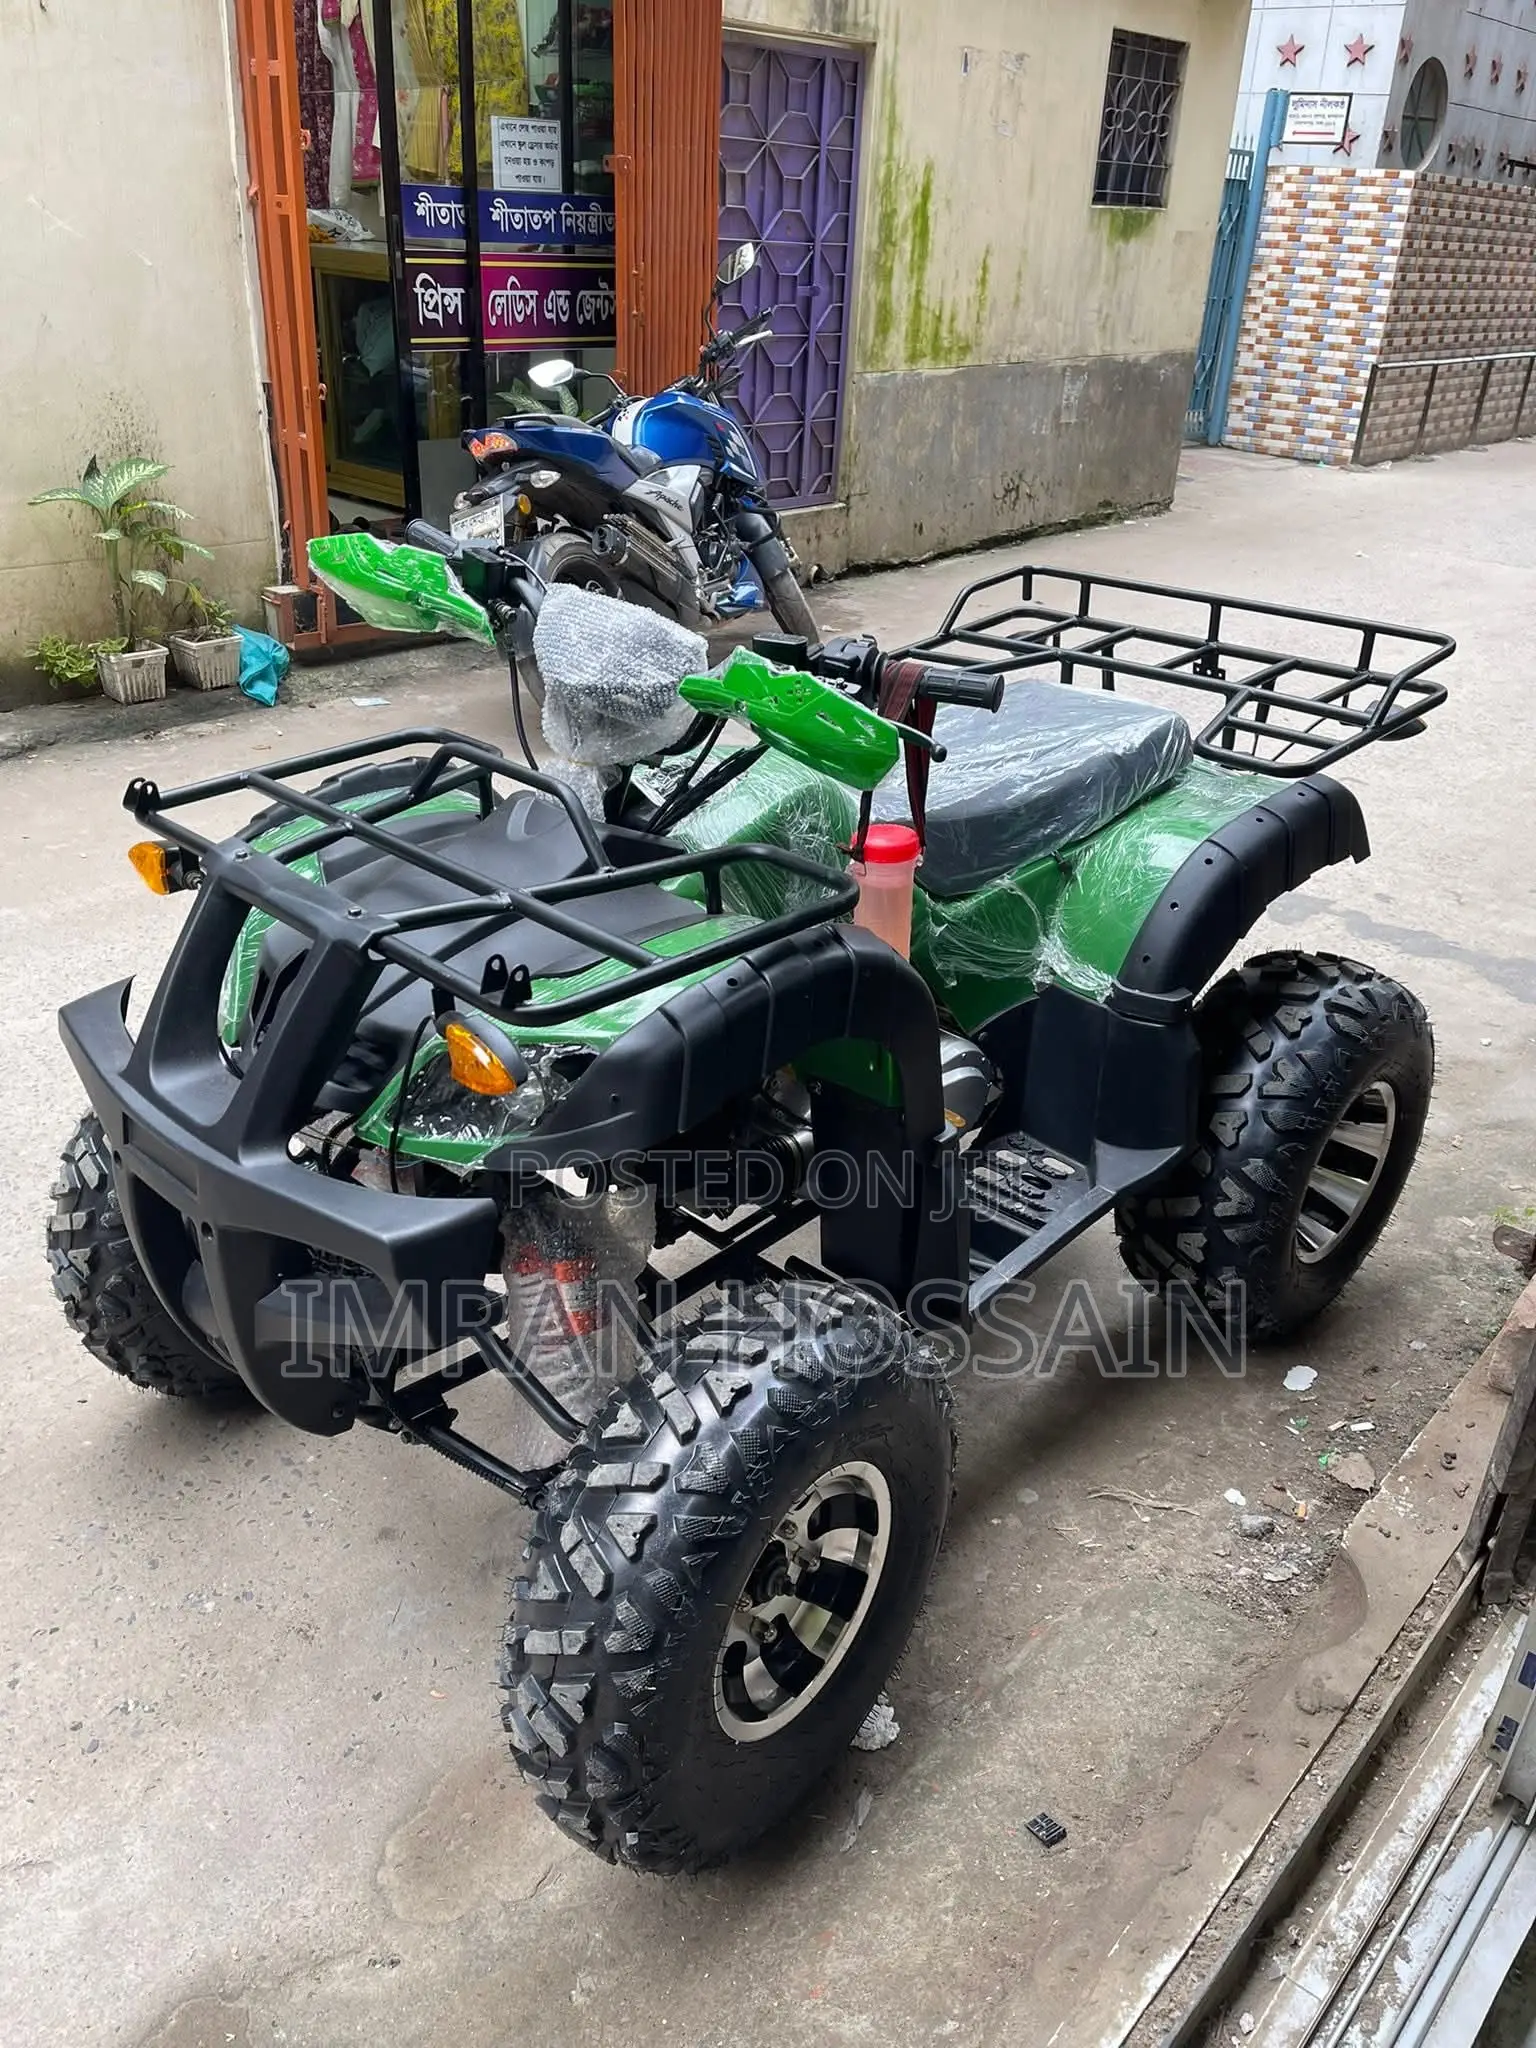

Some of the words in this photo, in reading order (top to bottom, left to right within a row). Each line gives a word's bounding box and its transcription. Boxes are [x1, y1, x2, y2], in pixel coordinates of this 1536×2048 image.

[489, 197, 557, 234] শীতাতপ
[412, 272, 465, 329] প্রিন্স
[488, 275, 539, 327] লেডিস
[644, 490, 685, 511] Apache
